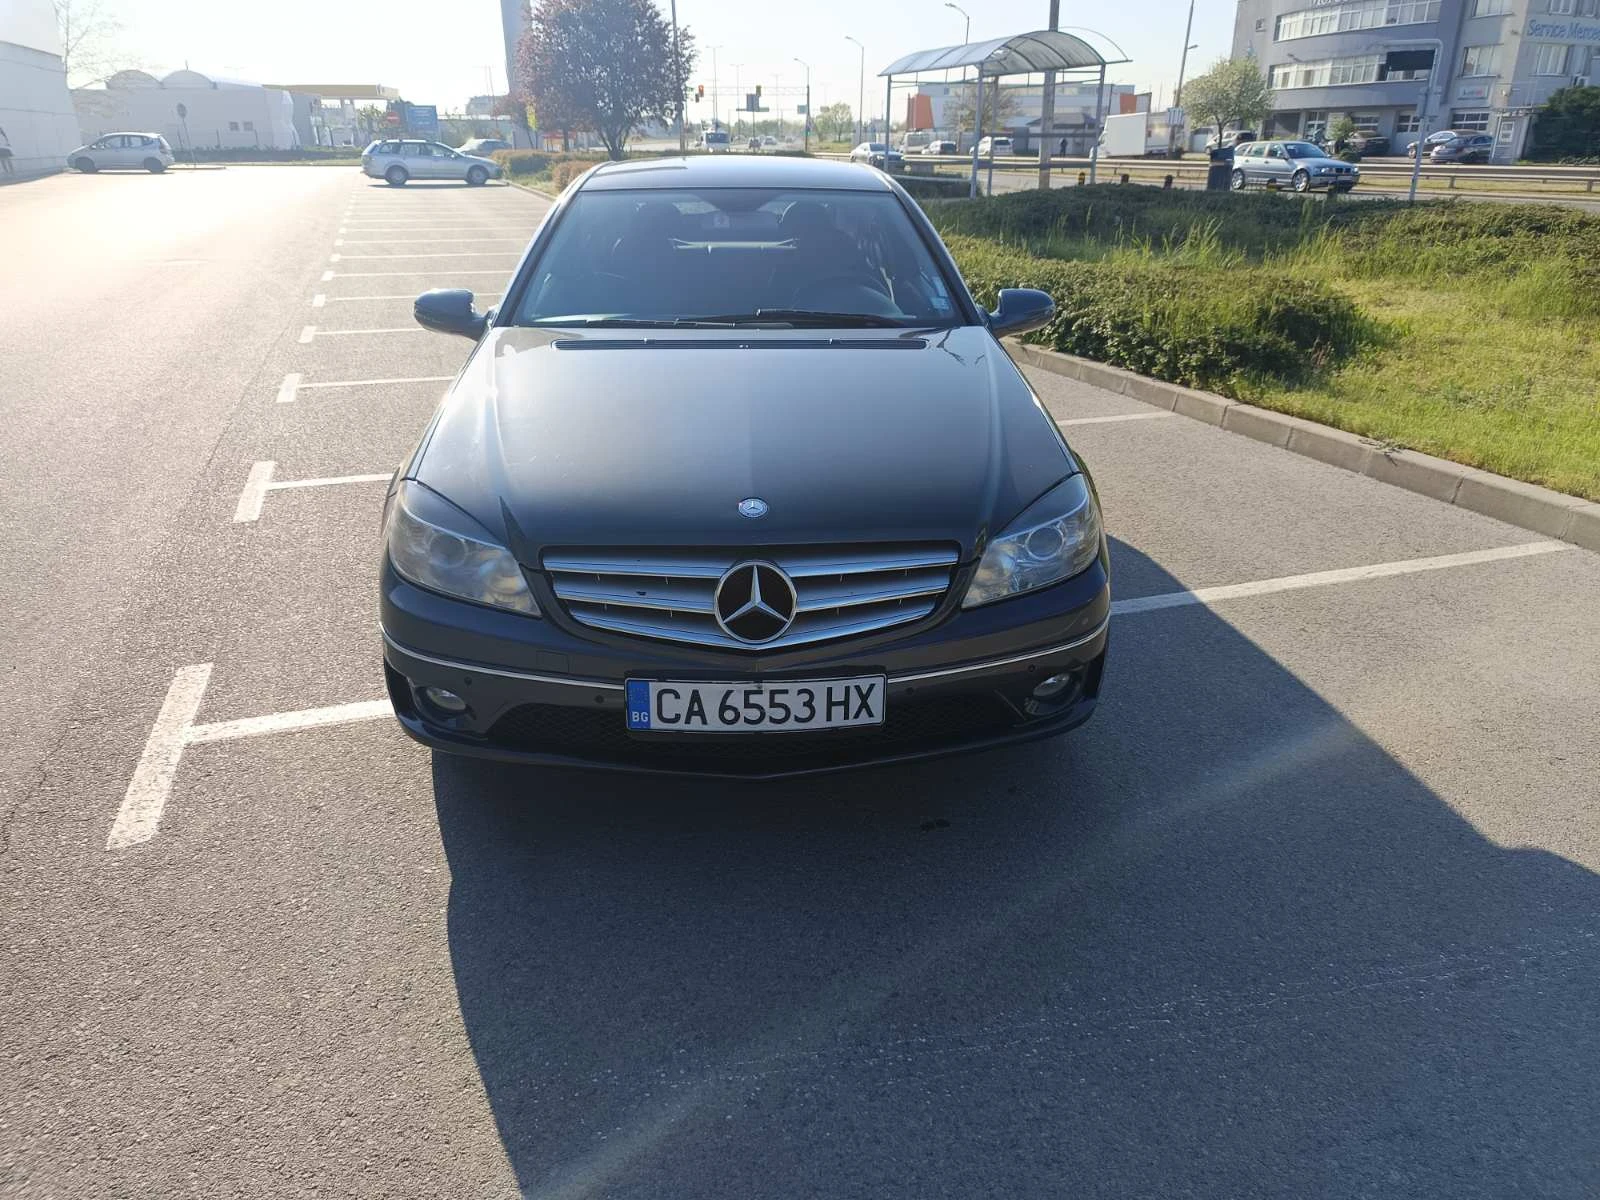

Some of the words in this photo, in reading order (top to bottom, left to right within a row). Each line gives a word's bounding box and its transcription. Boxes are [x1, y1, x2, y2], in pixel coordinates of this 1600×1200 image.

[1526, 19, 1566, 38] Service
[656, 688, 708, 725] CA
[718, 688, 816, 725] 6553
[825, 683, 876, 722] HX
[632, 711, 649, 722] BG
